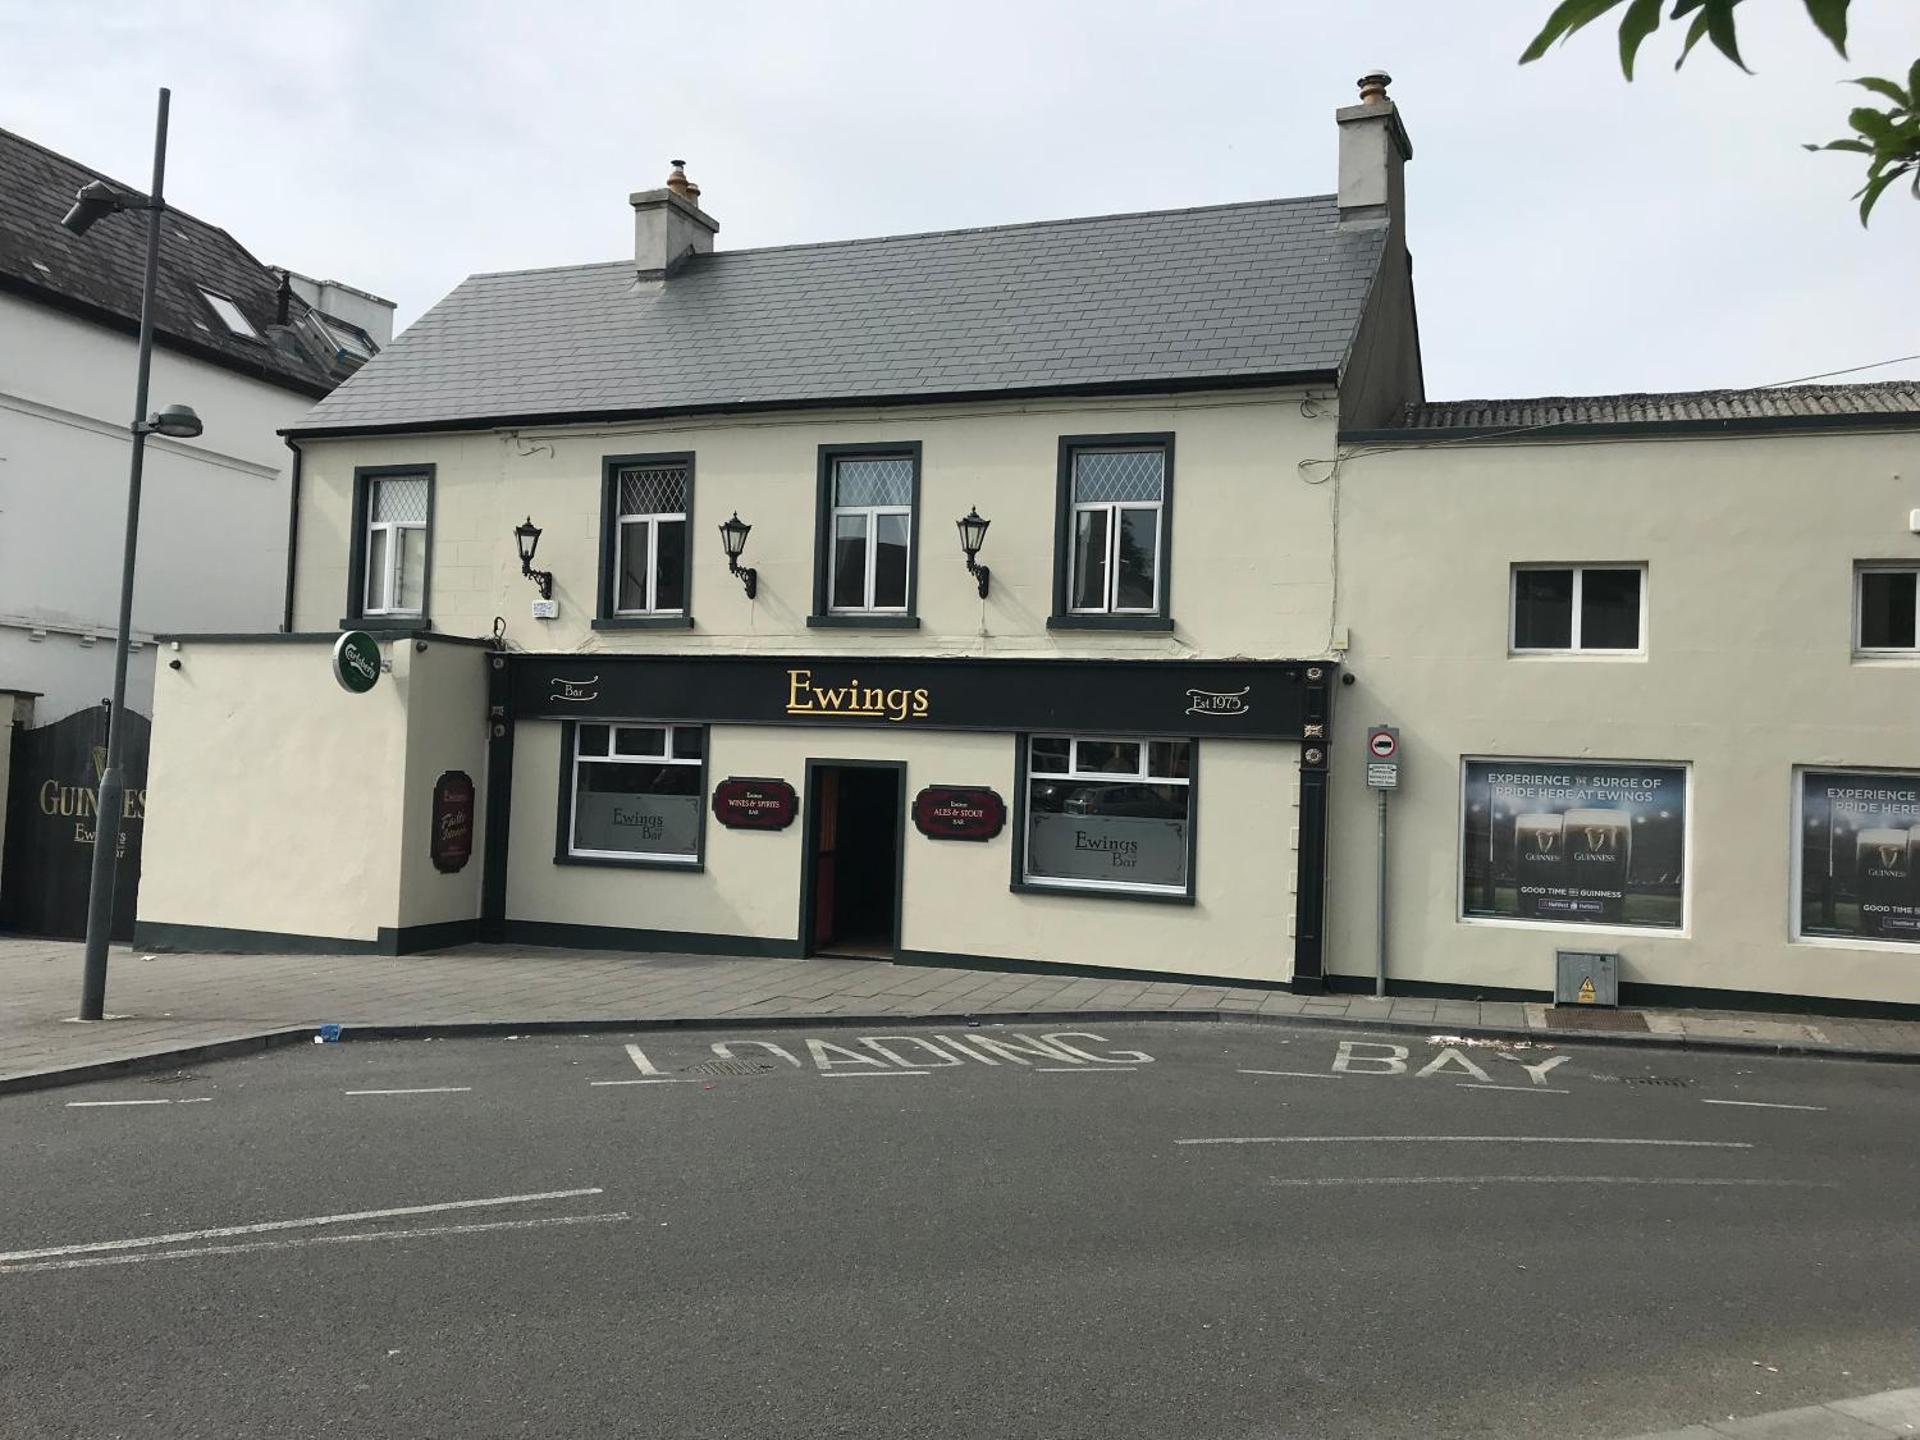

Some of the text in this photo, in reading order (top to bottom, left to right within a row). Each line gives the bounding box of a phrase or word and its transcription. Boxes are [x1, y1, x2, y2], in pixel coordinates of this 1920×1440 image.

[345, 643, 376, 680] Carlsberg
[565, 684, 584, 697] Bar
[785, 670, 929, 721] Ewings
[1193, 695, 1241, 709] Est 1975
[1487, 773, 1571, 787] EXPERIENCE
[1593, 776, 1638, 788] SURGE
[1641, 778, 1662, 789] OF
[1495, 786, 1654, 802] PRIDE HERE AT EWINGS
[1827, 787, 1917, 801] EXPERIENCE
[727, 799, 749, 807] WINES
[1835, 801, 1920, 815] PRIDE HERE
[612, 807, 664, 829] Ewings
[933, 808, 952, 816] ALES
[960, 809, 984, 818] STOUT
[642, 826, 662, 840] Bar
[1075, 830, 1138, 854] Ewings
[1112, 852, 1137, 867] Bar
[1573, 852, 1616, 861] GUINNESS
[1520, 886, 1546, 894] GOOD
[1547, 887, 1567, 896] TIME
[1580, 889, 1622, 898] GUINNESS
[1863, 904, 1890, 912] GOOD
[1891, 905, 1913, 914] TIME
[624, 1031, 1572, 1085] LOADING BAY
